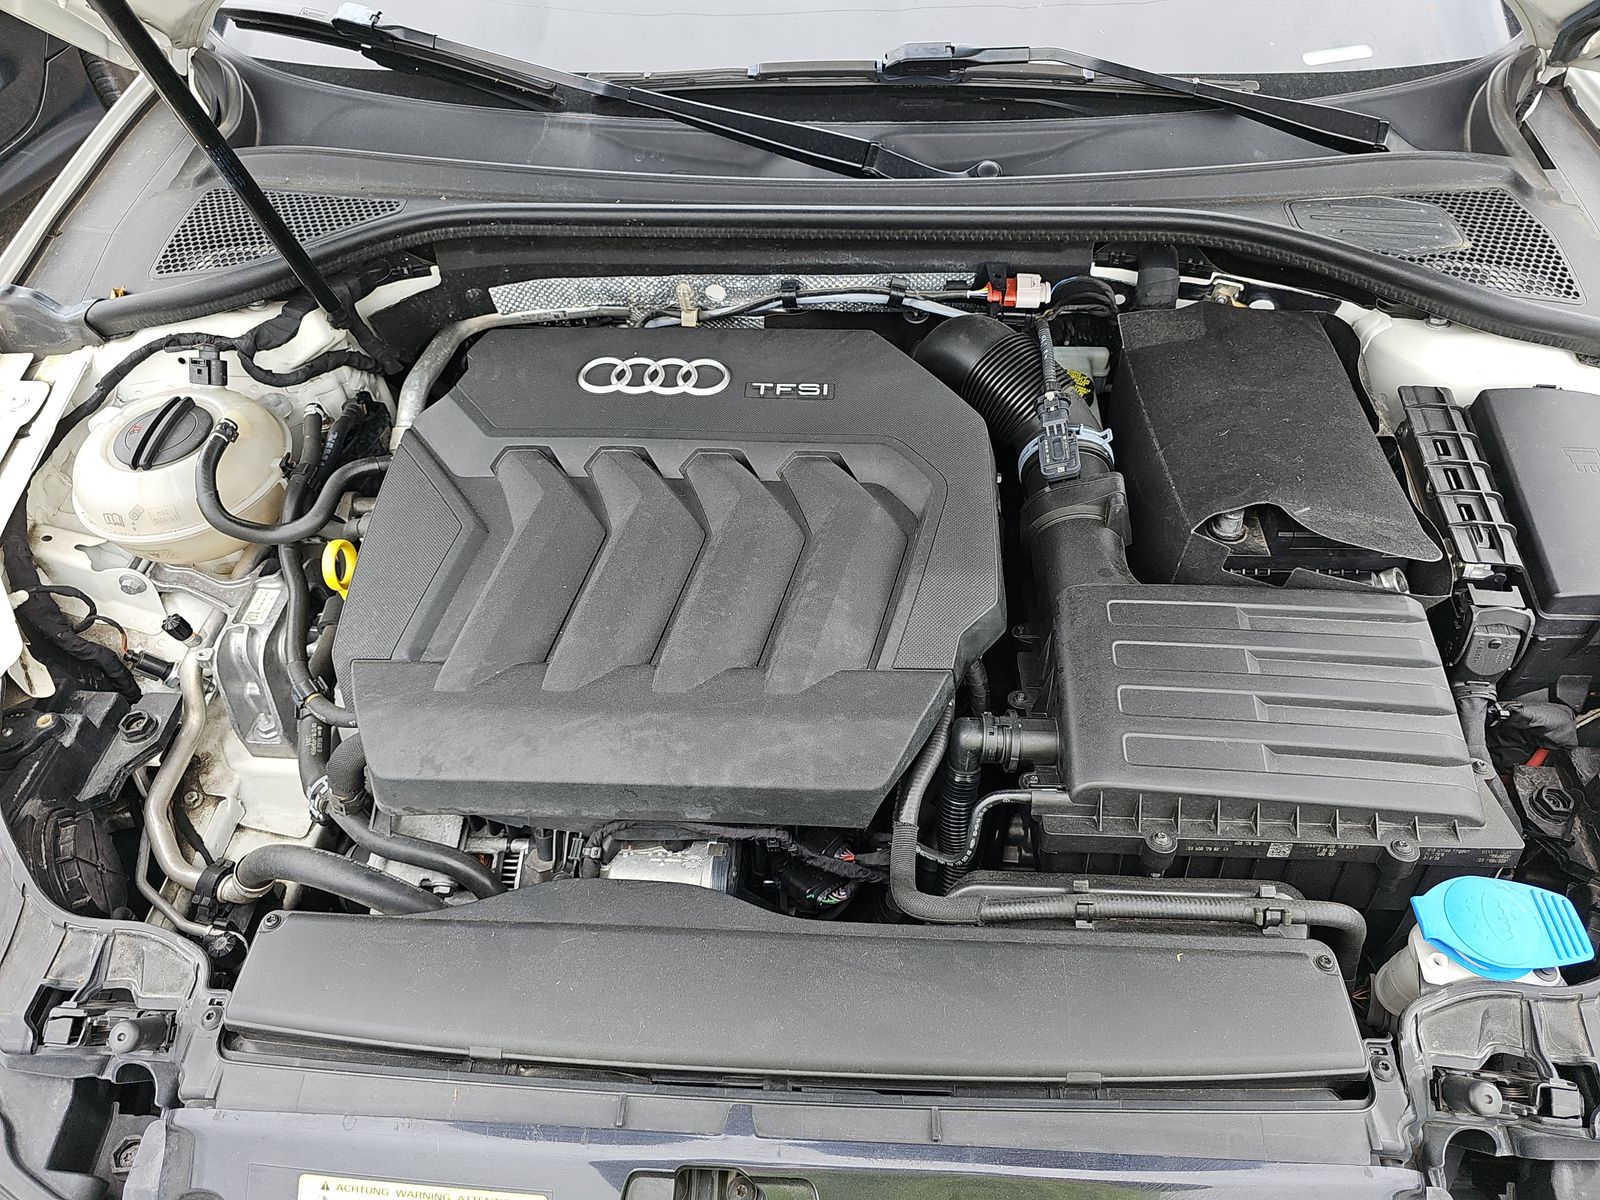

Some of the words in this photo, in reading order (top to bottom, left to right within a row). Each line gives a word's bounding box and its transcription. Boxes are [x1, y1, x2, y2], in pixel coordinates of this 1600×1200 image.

[752, 383, 828, 396] TFSI
[336, 1183, 389, 1196] ACHTUNG
[396, 1189, 451, 1200] WARNING
